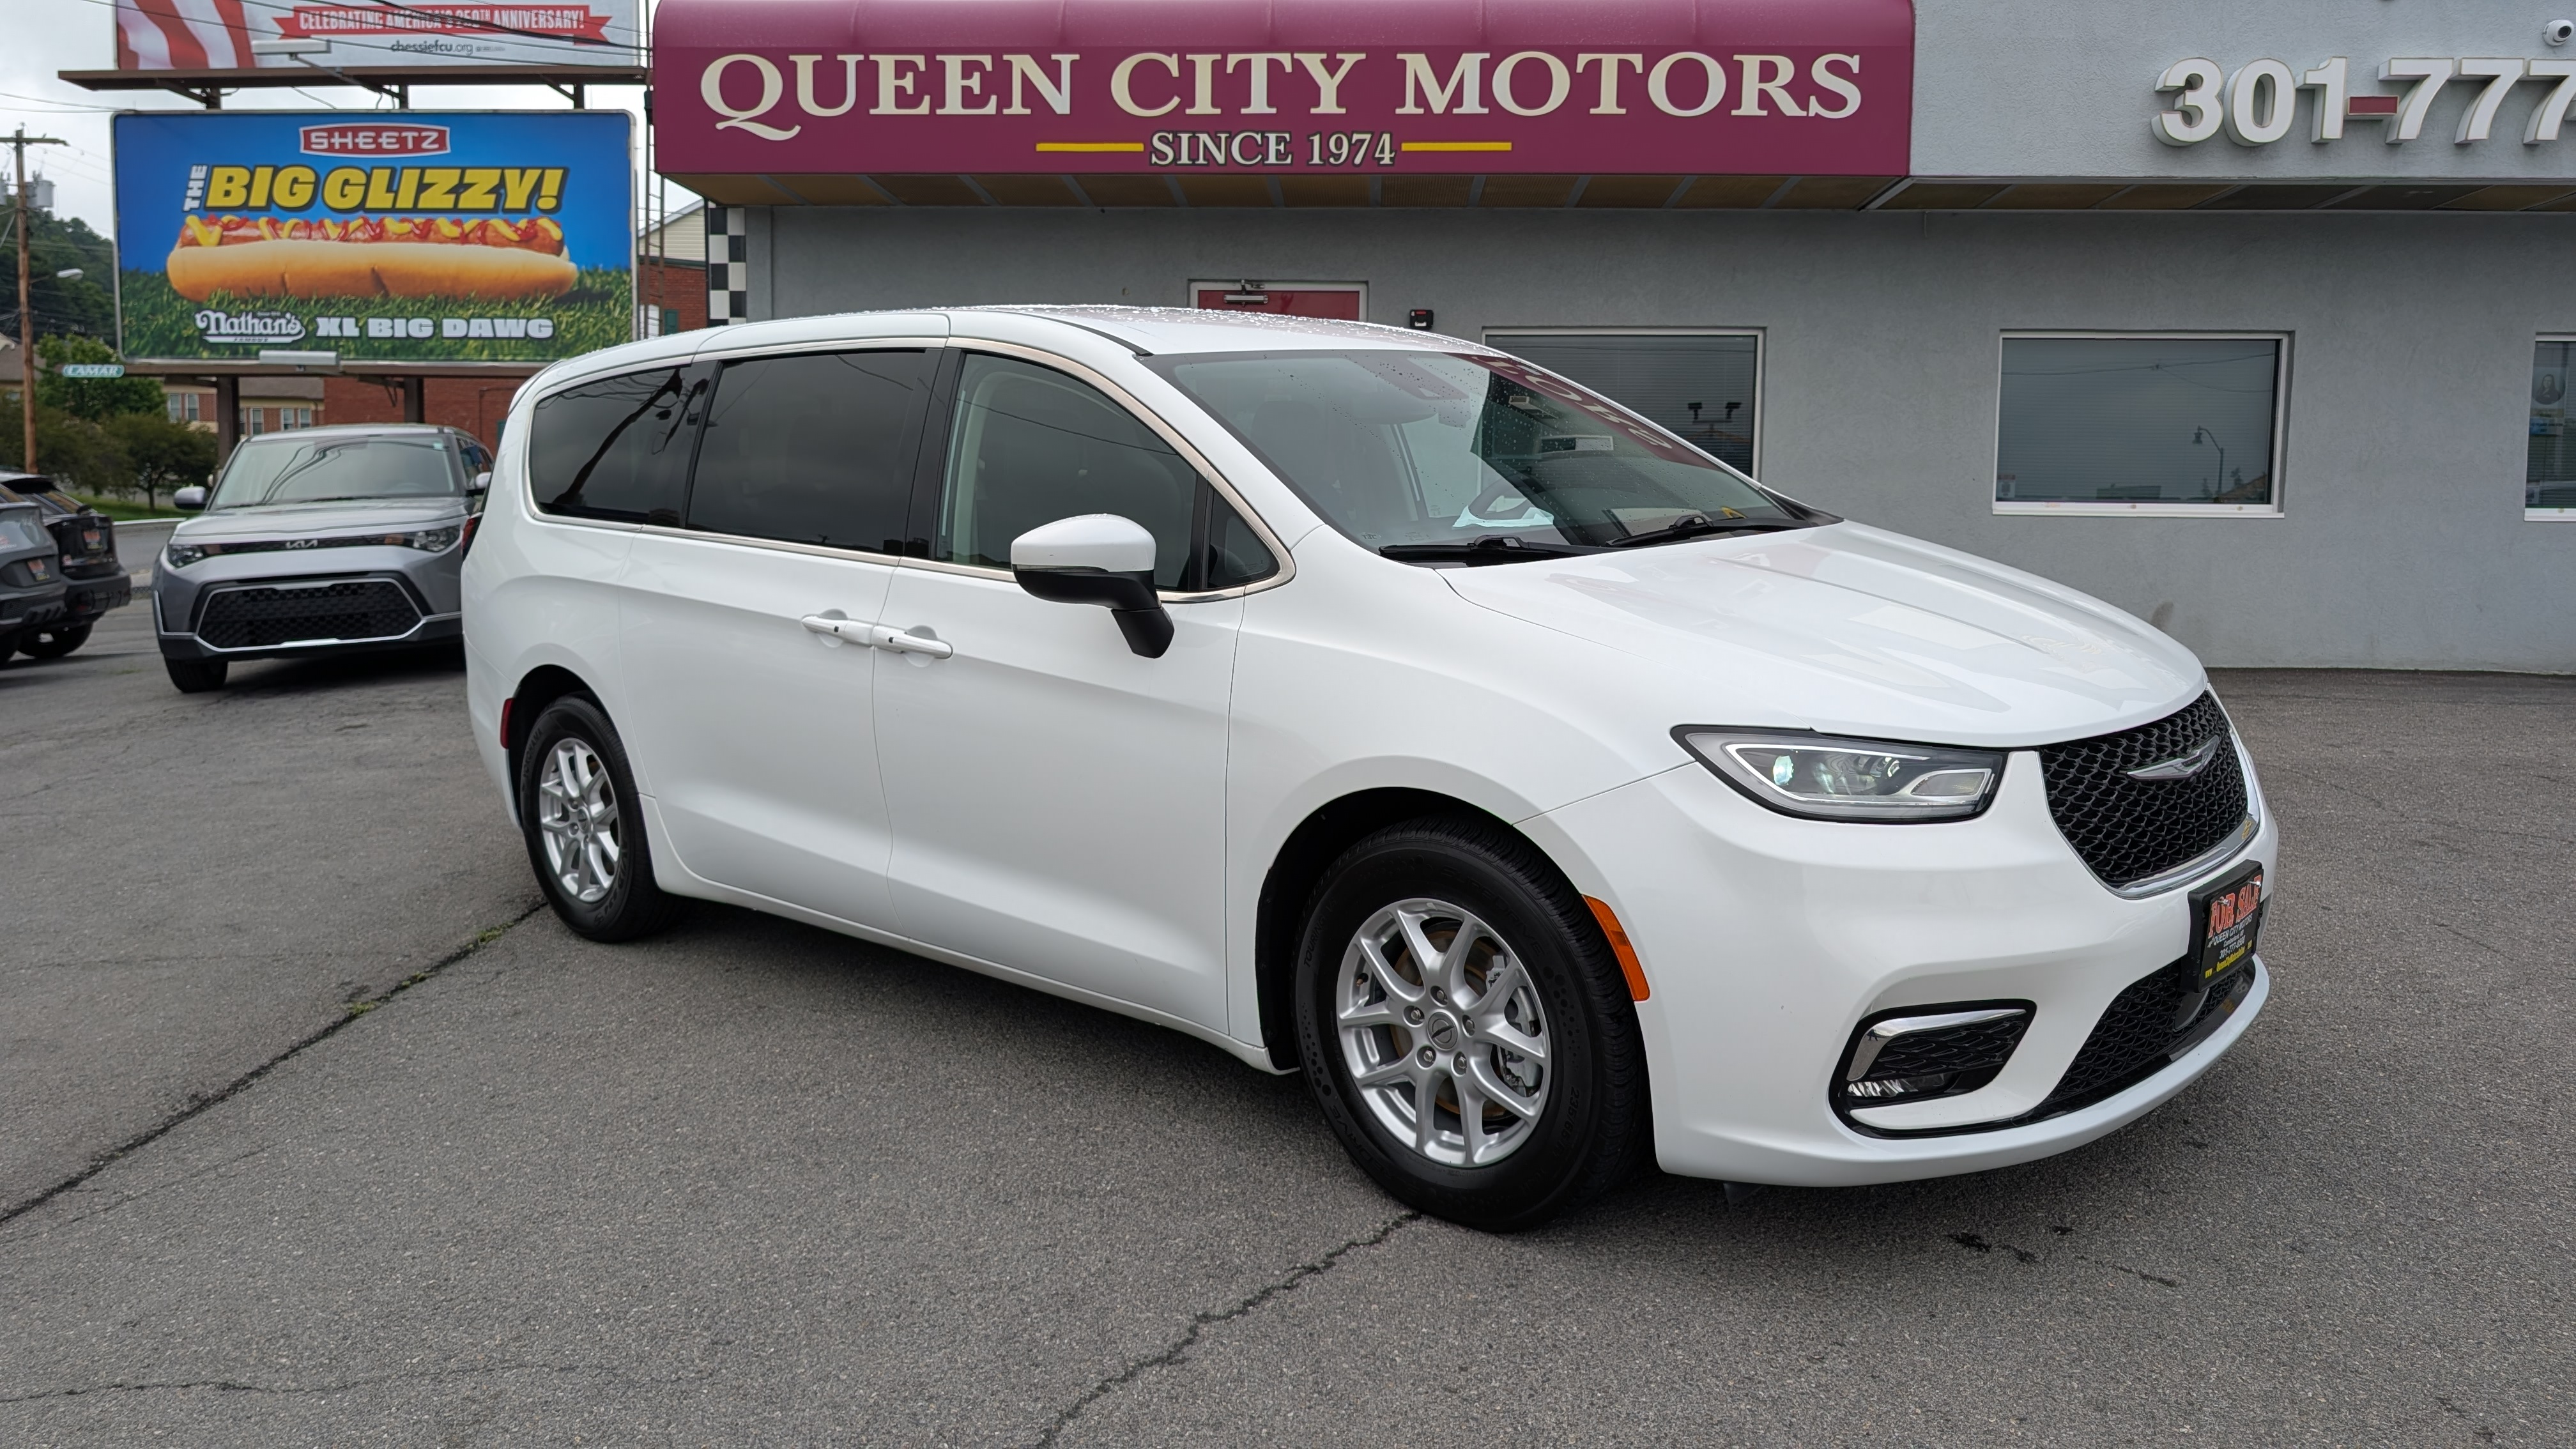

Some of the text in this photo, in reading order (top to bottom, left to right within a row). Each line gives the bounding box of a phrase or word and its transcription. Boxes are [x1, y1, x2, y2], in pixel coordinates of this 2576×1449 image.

[299, 10, 383, 30] CELEBRATING
[493, 9, 585, 29] ANNIVERSARY!
[700, 51, 1862, 141] QUEEN CITY MOTORS
[310, 131, 440, 150] SHEETZ
[1151, 132, 1396, 165] SINCE 1974
[183, 165, 565, 211] THE BIG GLIZZY!
[194, 310, 303, 335] Nathan's
[316, 317, 554, 339] XL BIG DAWG
[66, 366, 118, 376] LAMAR
[286, 539, 318, 549] KIA
[2208, 874, 2262, 939] FOR SALE
